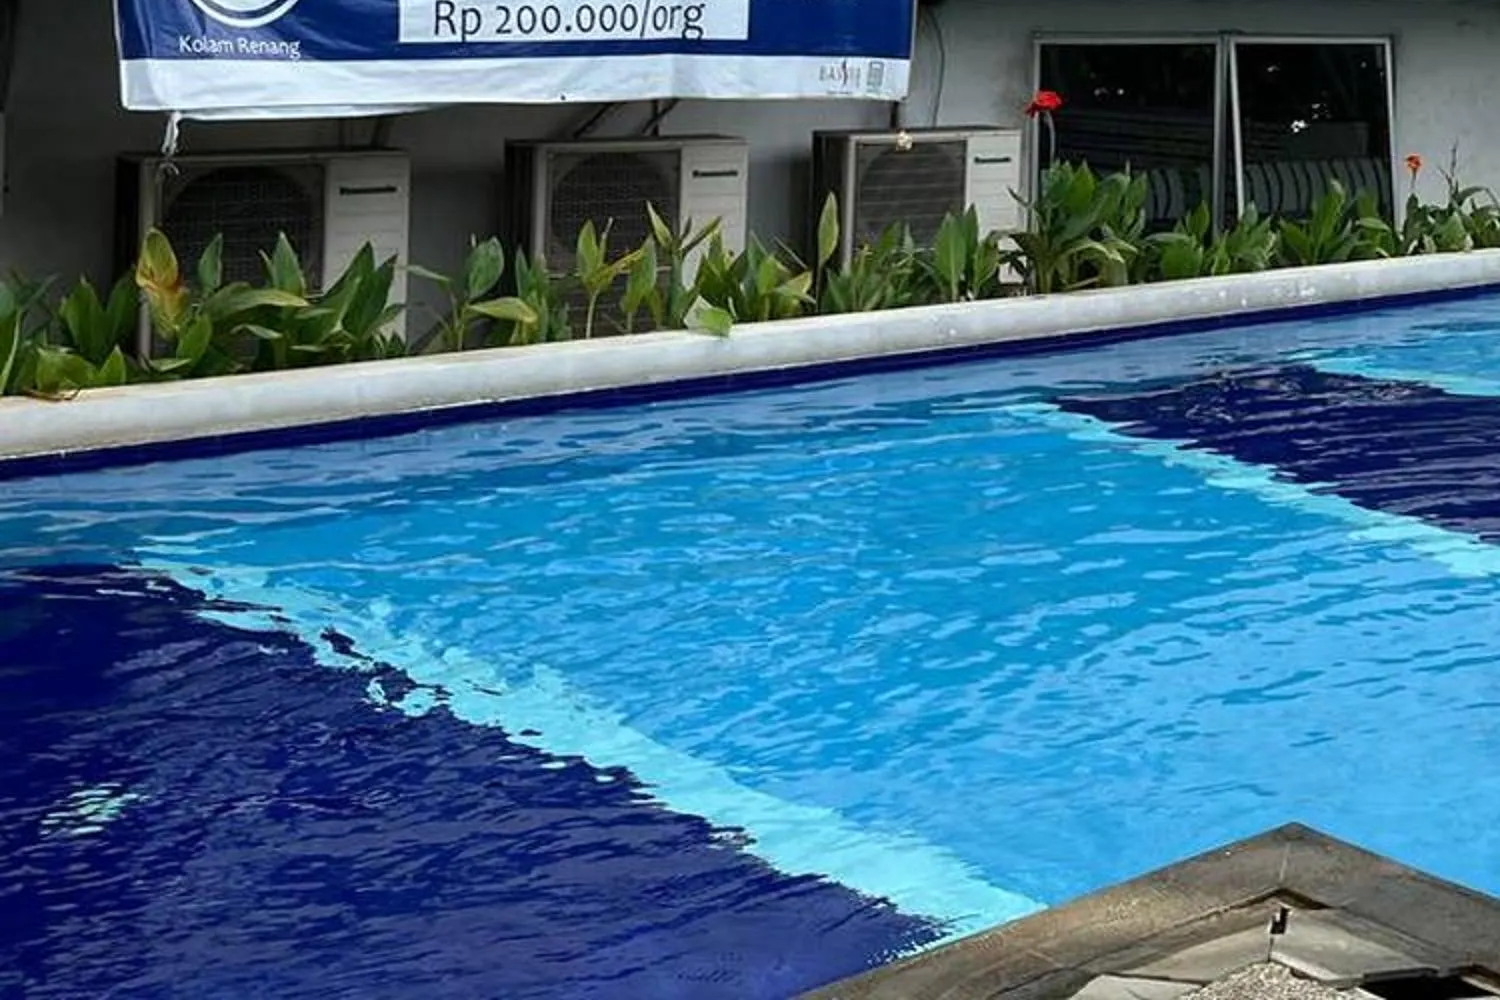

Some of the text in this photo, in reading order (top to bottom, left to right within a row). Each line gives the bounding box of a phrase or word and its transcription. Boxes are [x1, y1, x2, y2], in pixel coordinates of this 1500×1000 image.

[434, 0, 482, 42] Rp
[179, 35, 301, 60] Kolam Renang
